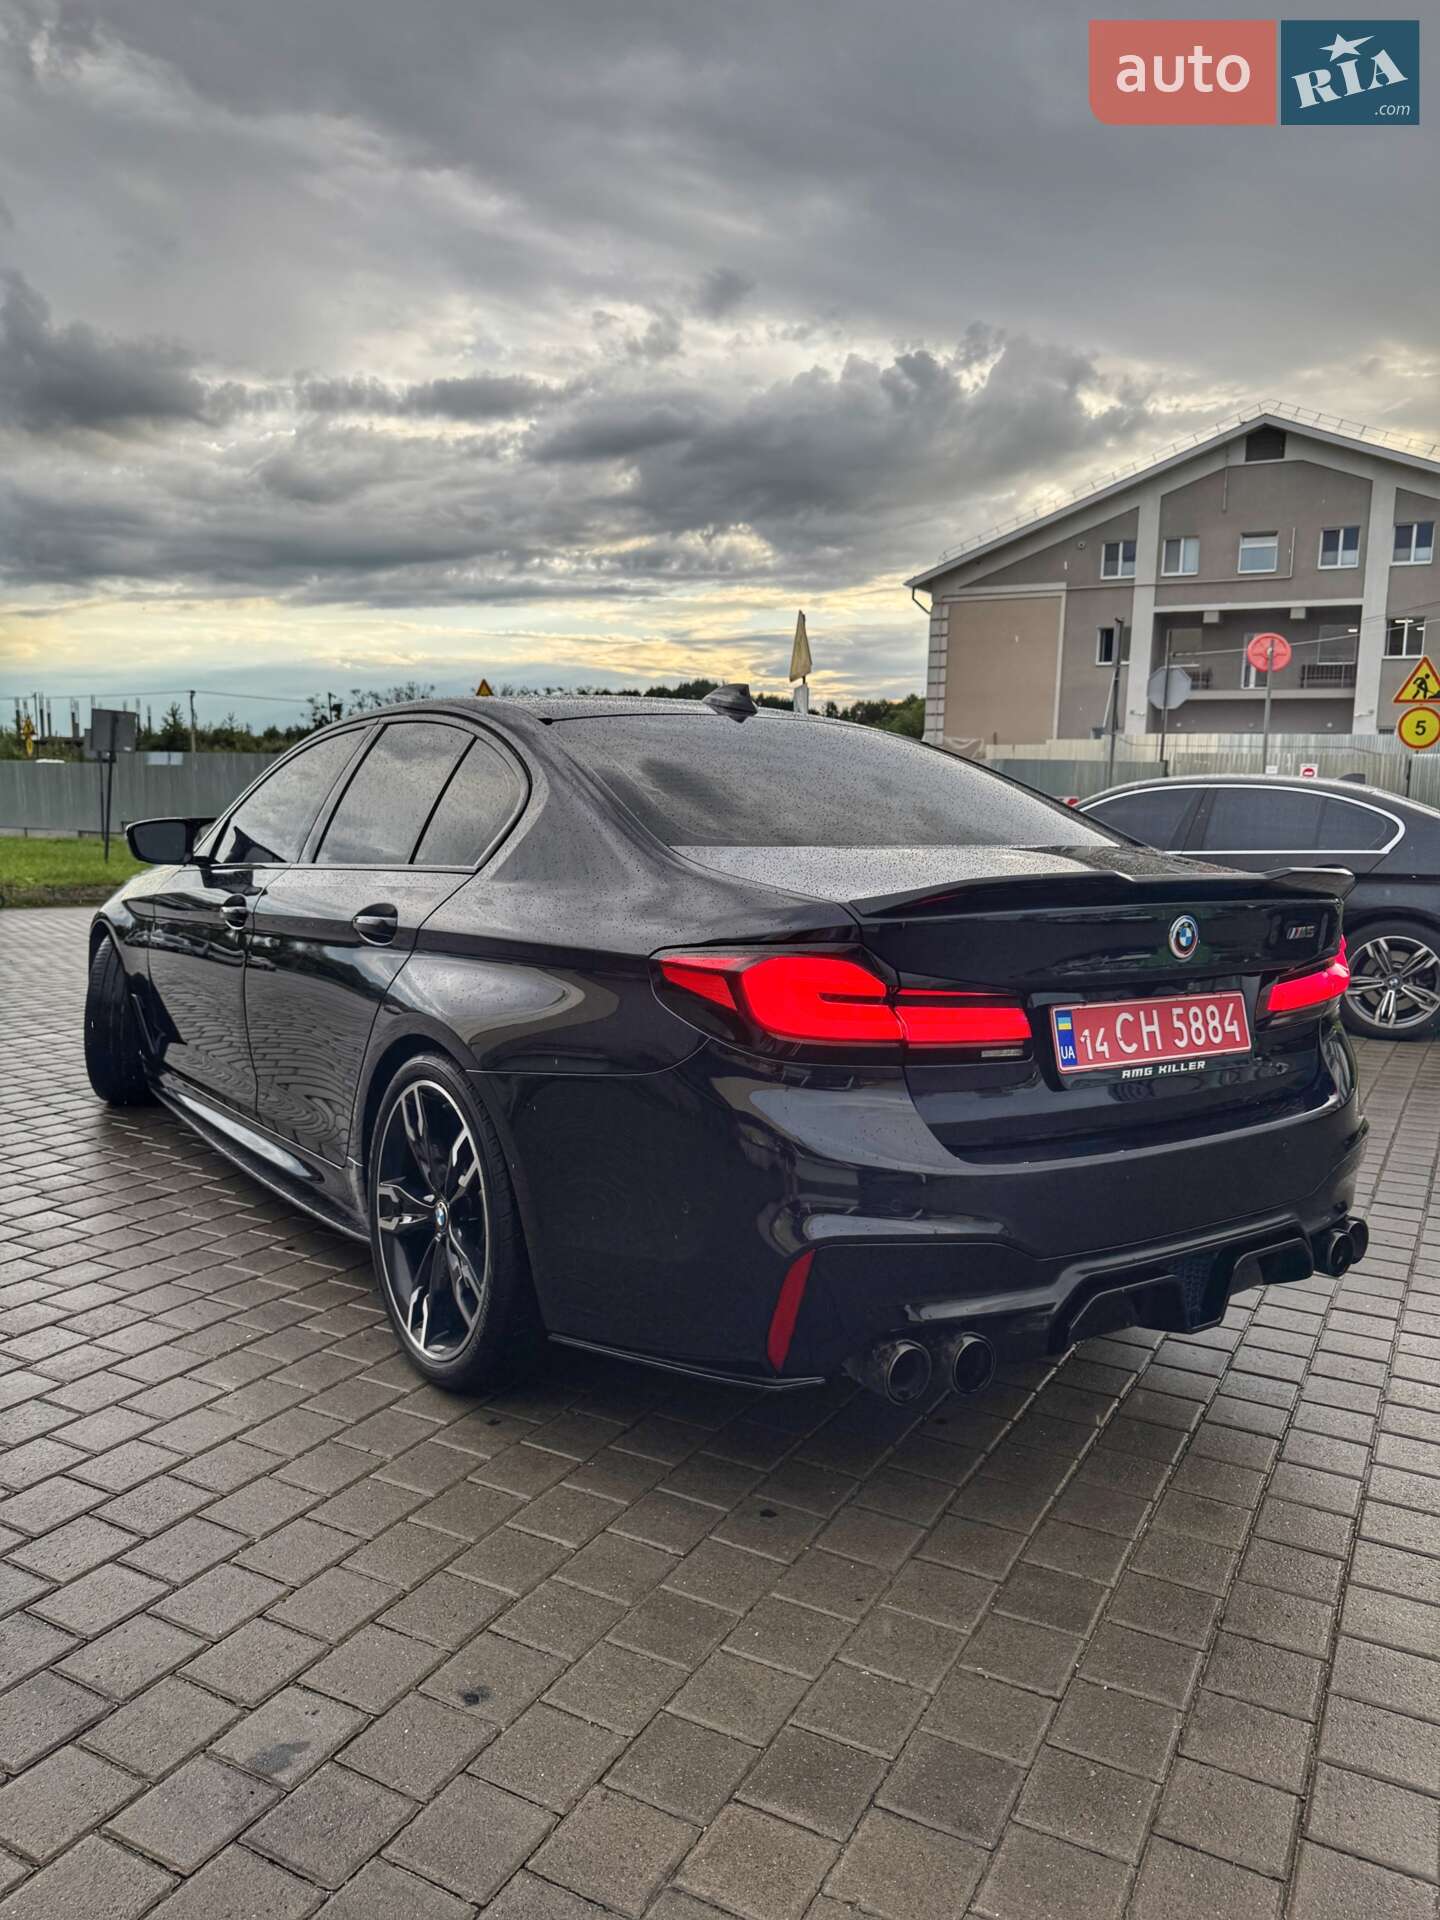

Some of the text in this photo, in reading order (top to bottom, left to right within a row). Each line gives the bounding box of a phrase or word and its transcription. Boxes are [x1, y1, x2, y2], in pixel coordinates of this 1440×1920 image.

[1415, 720, 1427, 736] 5
[1171, 1002, 1241, 1048] 5884
[1061, 1045, 1076, 1059] UA
[1122, 1060, 1206, 1079] AMG KILLER
